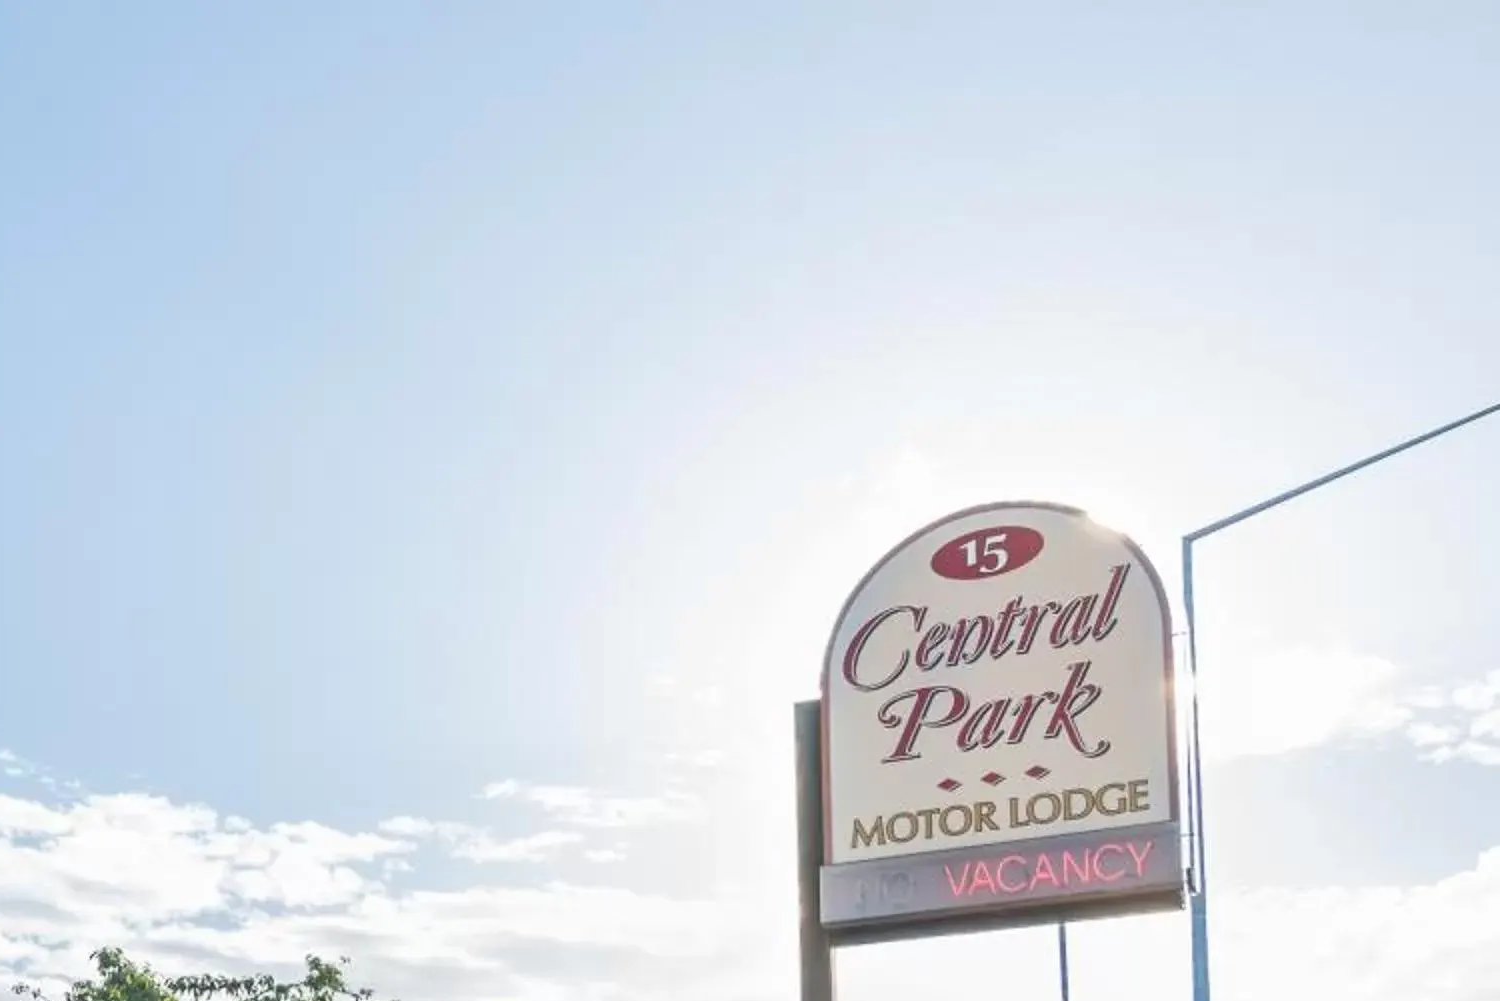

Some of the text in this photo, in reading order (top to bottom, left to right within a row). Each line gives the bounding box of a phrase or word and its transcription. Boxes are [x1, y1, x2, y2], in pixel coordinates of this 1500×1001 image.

[960, 533, 1009, 574] 15
[842, 561, 1132, 692] Central
[877, 659, 1111, 764] Park
[850, 779, 1151, 850] MOTOR LODGE
[943, 840, 1155, 897] VACANCY
